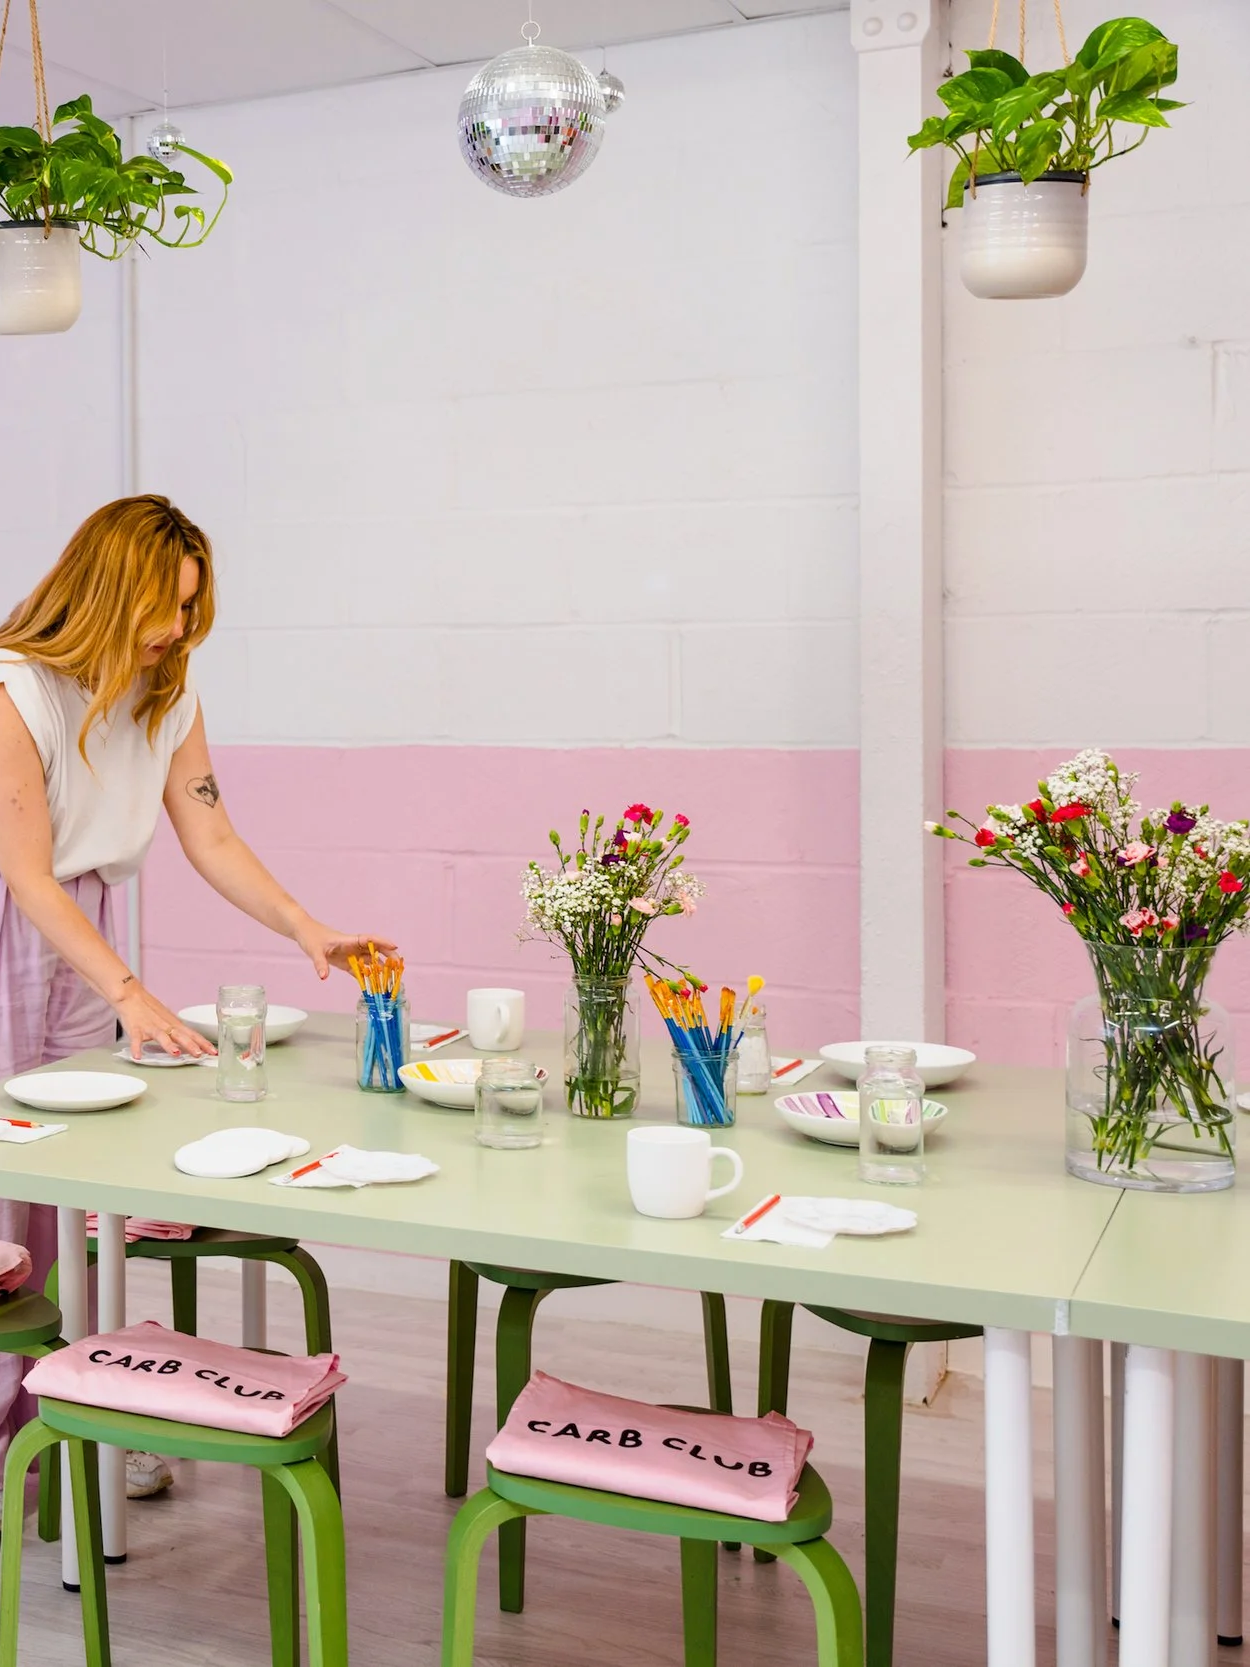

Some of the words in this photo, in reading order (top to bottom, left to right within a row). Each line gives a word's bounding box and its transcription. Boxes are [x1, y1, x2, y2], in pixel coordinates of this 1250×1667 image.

[88, 1349, 183, 1375] CARB
[527, 1420, 643, 1449] CARB
[661, 1437, 773, 1478] CLUB
